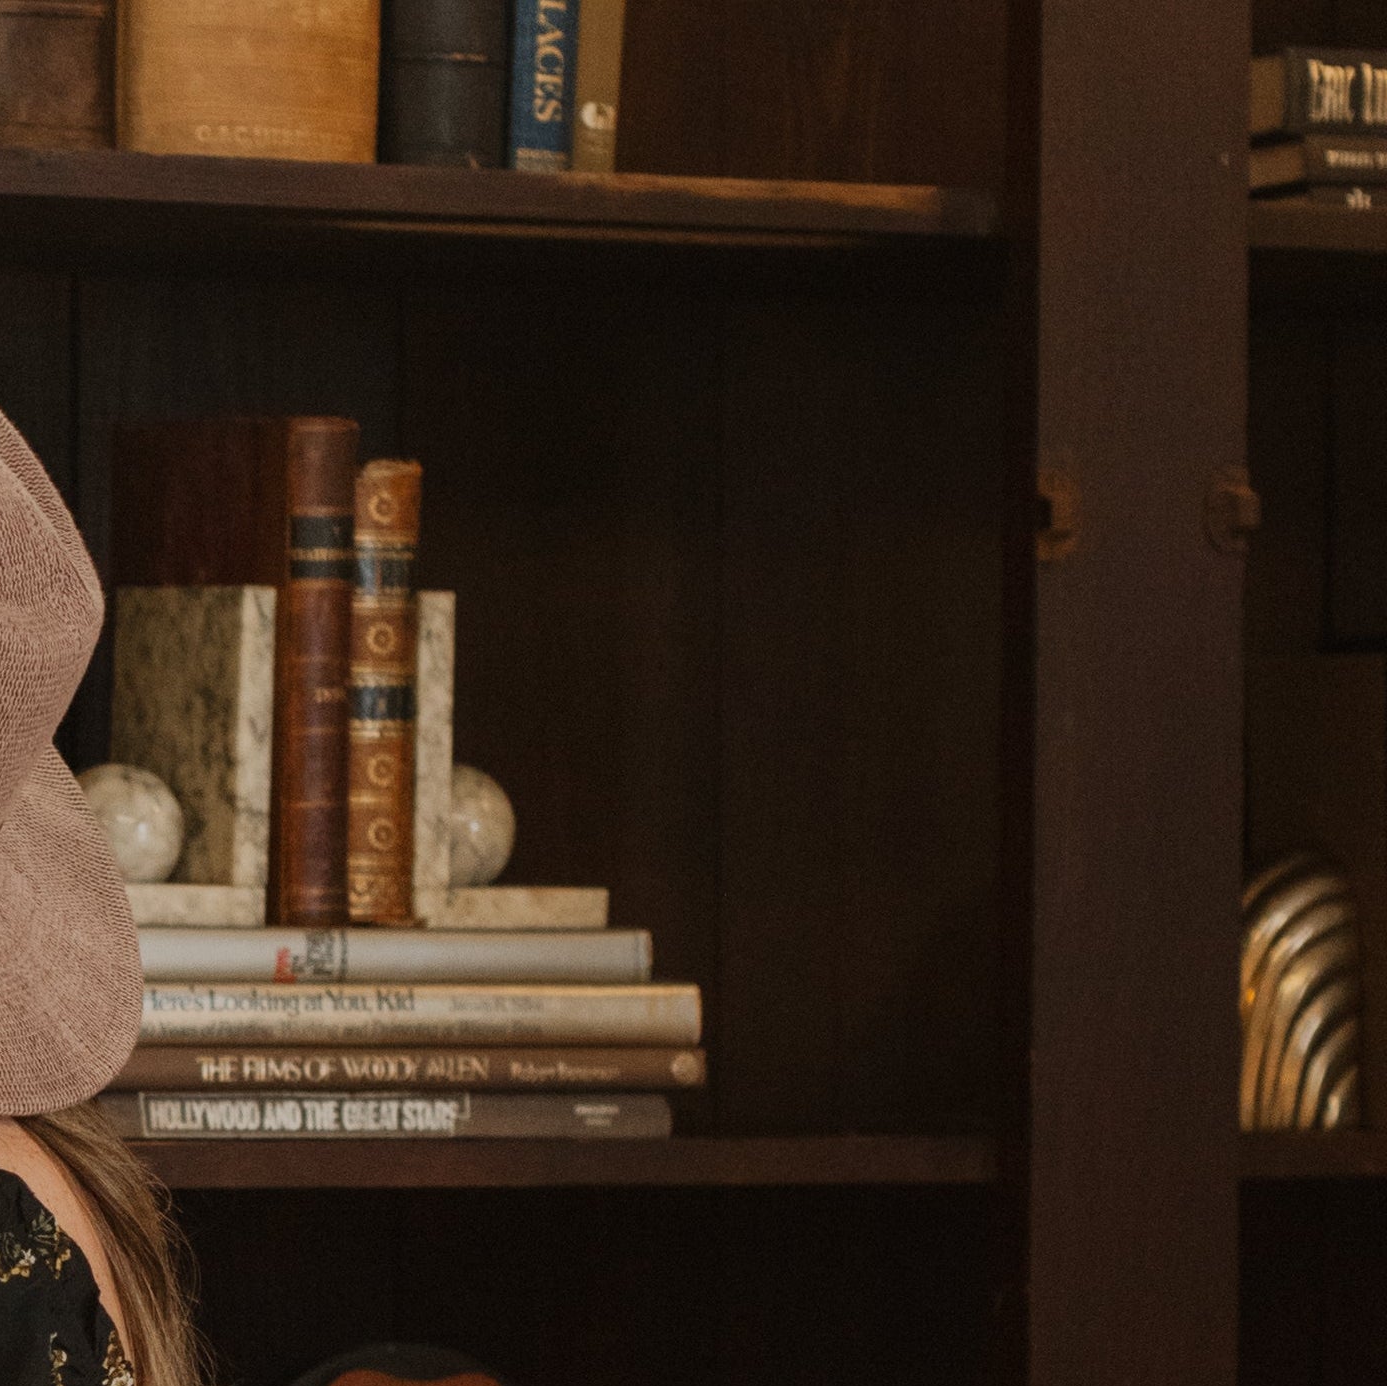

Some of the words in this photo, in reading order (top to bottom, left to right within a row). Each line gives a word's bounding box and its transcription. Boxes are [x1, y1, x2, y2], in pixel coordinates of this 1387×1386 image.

[150, 984, 204, 1011] ere's
[208, 988, 301, 1016] Looking
[304, 992, 323, 1012] at
[326, 989, 372, 1013] You,
[377, 989, 416, 1012] Kid
[196, 1056, 240, 1082] THE
[243, 1057, 301, 1082] FILMS
[303, 1057, 337, 1081] OF
[340, 1056, 422, 1082] WOODY
[426, 1056, 490, 1081] ALLEN
[149, 1100, 261, 1131] HOLLYWOOD
[263, 1100, 302, 1131] AND
[304, 1100, 339, 1131] THE
[341, 1100, 400, 1131] GREAT
[401, 1100, 456, 1131] STARS
